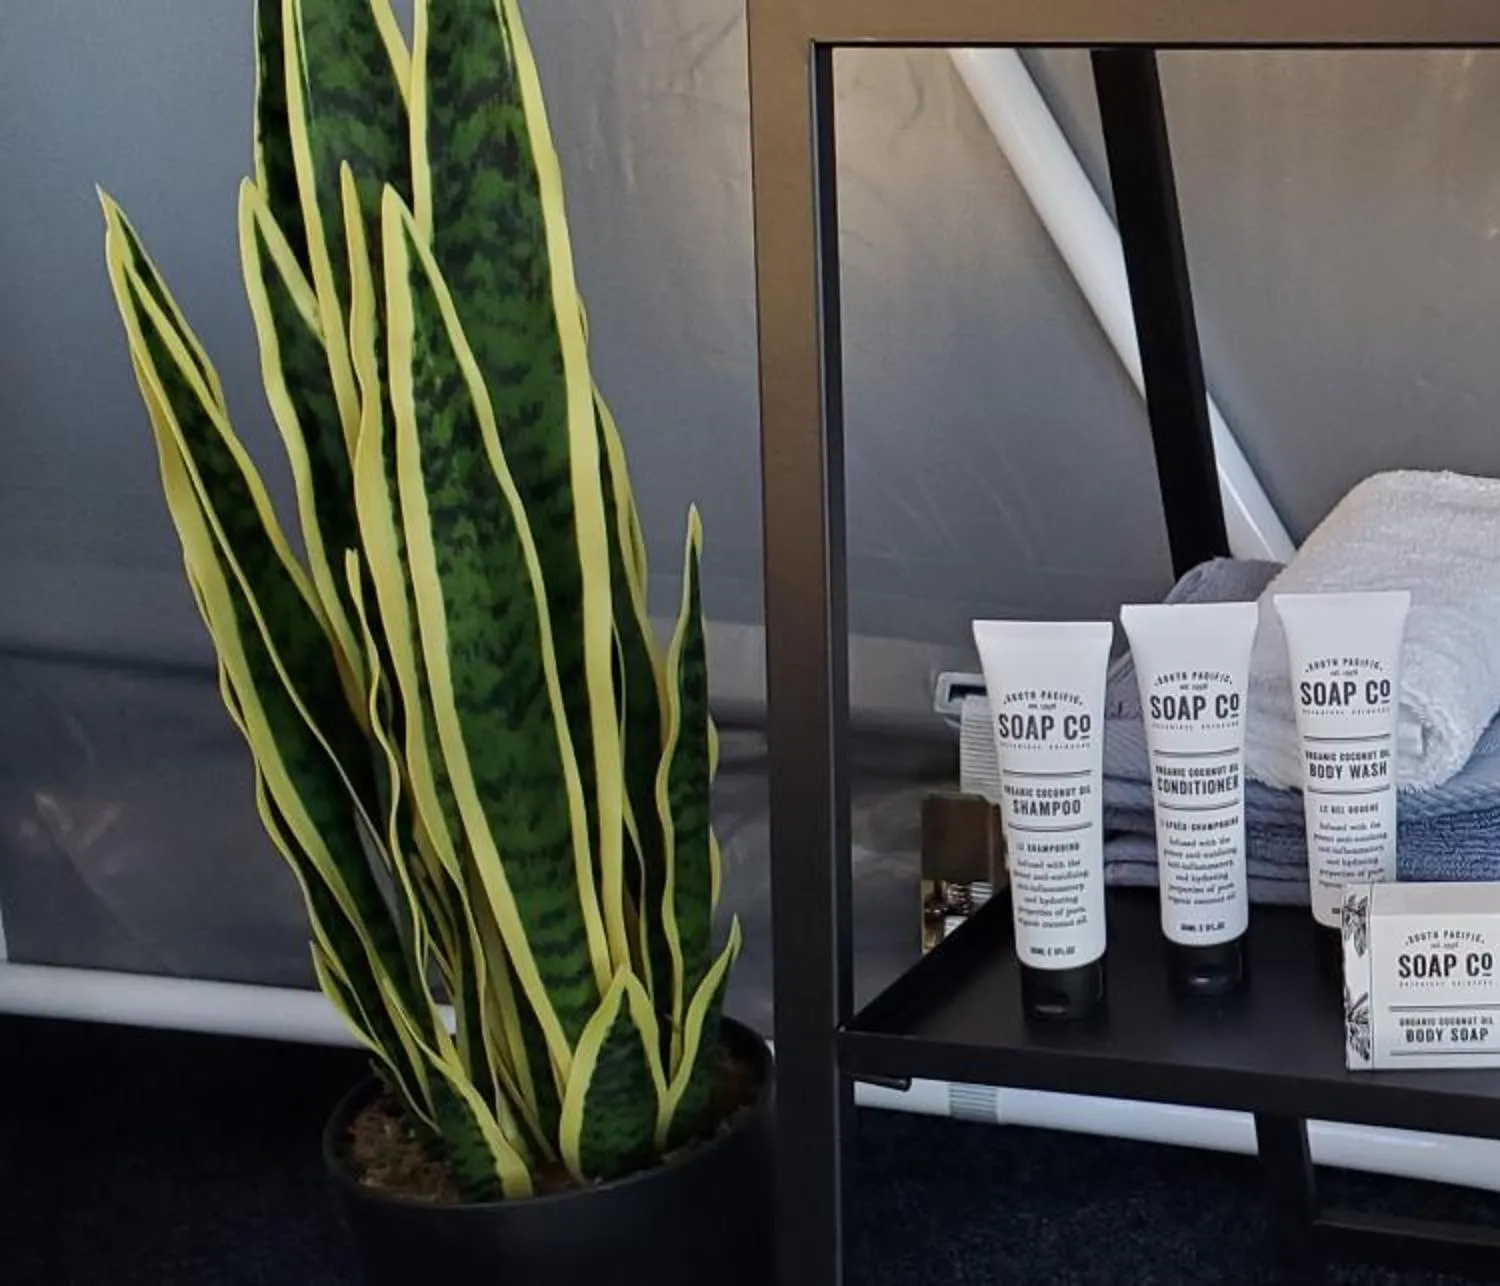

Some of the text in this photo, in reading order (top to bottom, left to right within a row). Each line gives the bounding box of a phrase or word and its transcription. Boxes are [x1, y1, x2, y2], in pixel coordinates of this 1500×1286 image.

[1343, 658, 1380, 669] PACIFIC
[1192, 671, 1230, 682] PACIFIC
[1041, 690, 1080, 704] PACIFIC
[1300, 681, 1357, 706] SOAP
[1150, 695, 1206, 720] SOAP
[999, 713, 1055, 740] SOAP
[1340, 751, 1377, 761] COCONUT
[1188, 766, 1226, 778] COCONUT
[1309, 761, 1387, 780] BODY WASH
[1157, 774, 1239, 795] CONDITIONER
[1036, 787, 1076, 798] COCONUT
[1013, 798, 1081, 817] SHAMPOO
[1408, 930, 1482, 944] SOUTH PACIFIC
[1398, 953, 1457, 979] SOAP
[1439, 1016, 1478, 1026] COCONUT
[1406, 1027, 1489, 1042] BODY SOAP
